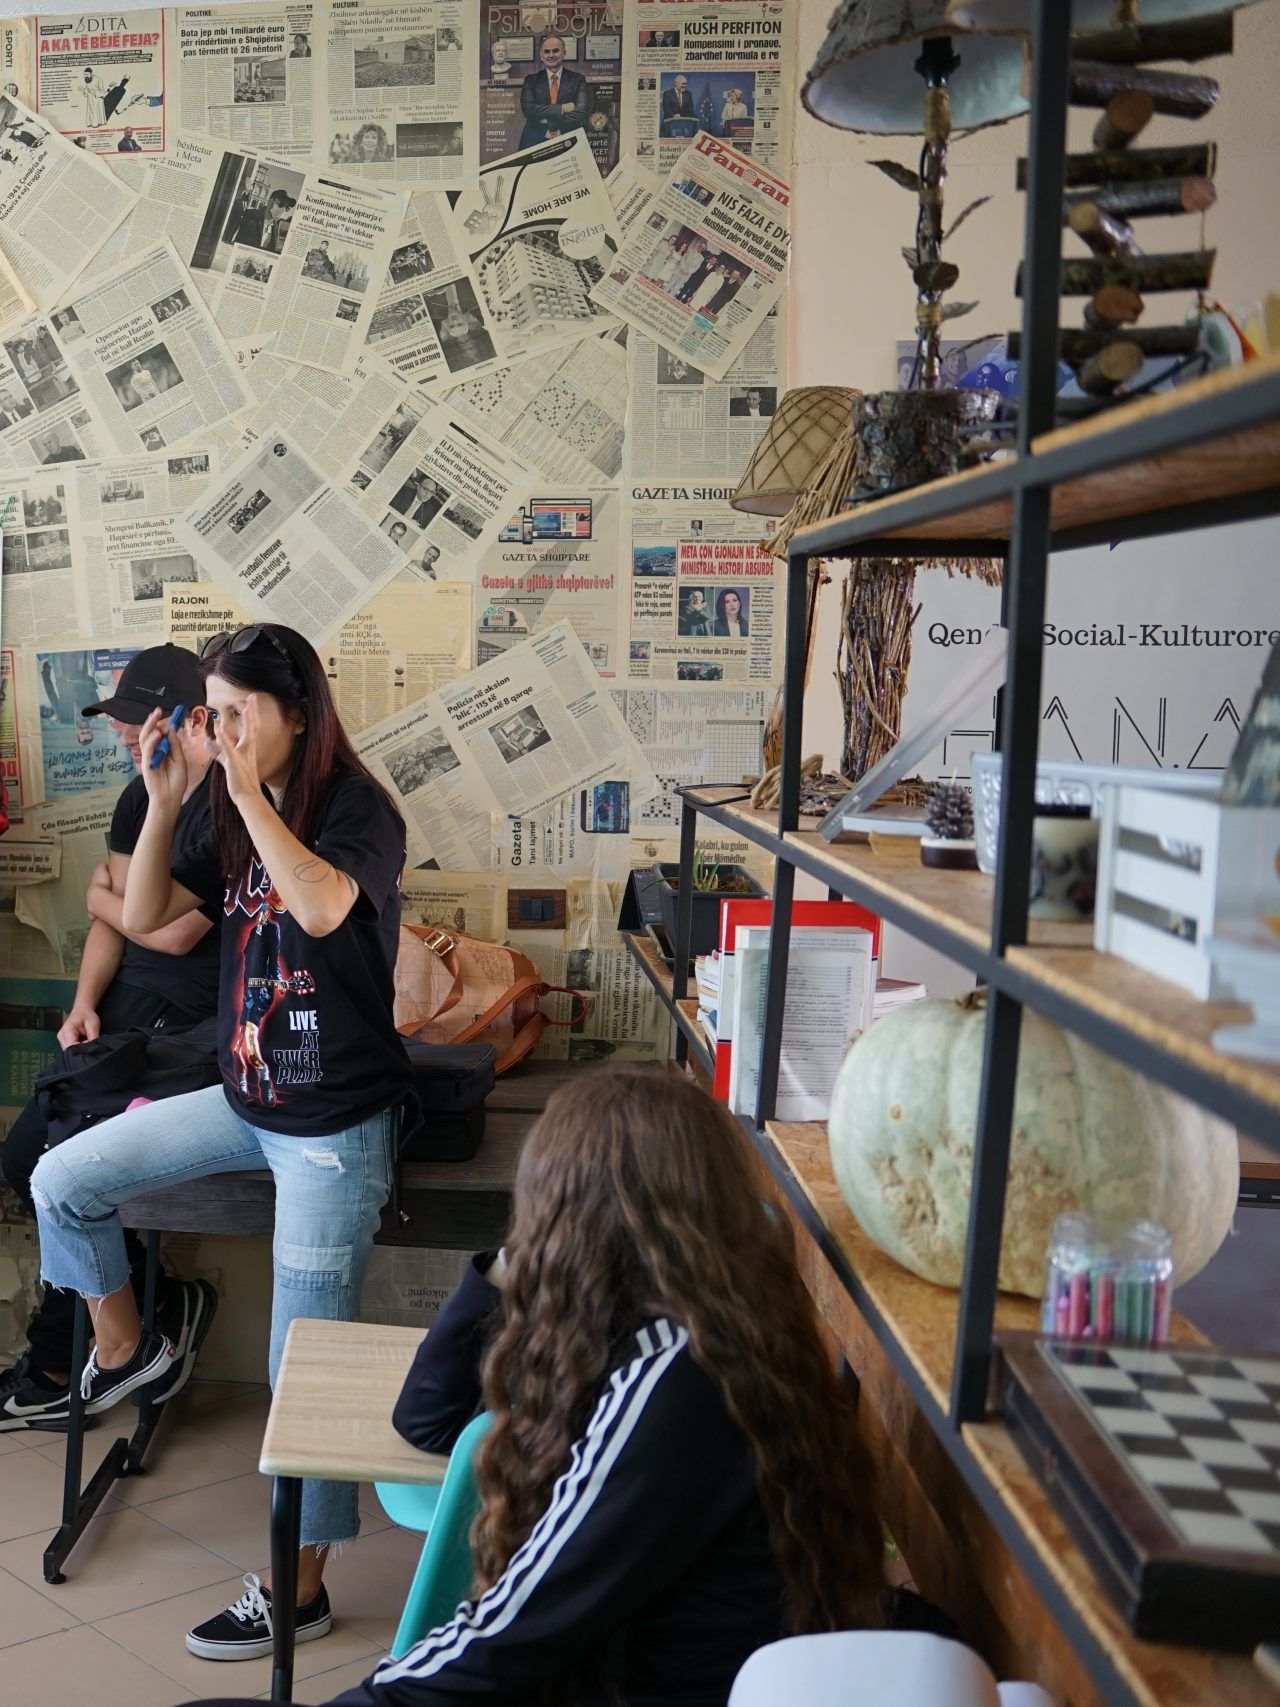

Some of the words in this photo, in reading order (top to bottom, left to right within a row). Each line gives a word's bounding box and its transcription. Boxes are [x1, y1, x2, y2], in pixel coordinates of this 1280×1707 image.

[185, 9, 212, 17] POLITIKE
[86, 16, 128, 32] DITA
[180, 28, 198, 38] Bota
[199, 28, 211, 38] jep
[213, 26, 228, 36] mbi
[266, 25, 285, 33] euro
[683, 21, 718, 35] KUSH
[721, 20, 782, 35] PERFITON
[3, 29, 12, 69] SPORTI
[50, 38, 70, 51] KA
[72, 33, 88, 50] TË
[90, 31, 120, 49] BËJË
[121, 31, 160, 47] FEJA?
[180, 39, 193, 48] për
[194, 35, 236, 46] rindërtimin
[244, 33, 285, 44] Shqipërisë
[683, 38, 735, 49] Kompensimi
[183, 49, 197, 58] pas
[198, 46, 229, 56] tërmetit
[239, 45, 250, 53] 26
[251, 43, 283, 53] nëntorit
[684, 50, 722, 61] zbardhet
[724, 50, 758, 60] formula
[768, 50, 779, 59] re
[552, 192, 573, 208] ARE
[573, 186, 590, 200] WE
[521, 201, 552, 219] HOME
[716, 190, 739, 212] NIS
[735, 203, 766, 228] FAZA
[701, 214, 730, 237] kushtet
[725, 229, 742, 246] për
[709, 205, 735, 227] Shtëpi
[731, 220, 746, 233] me
[742, 226, 765, 245] kredi
[631, 486, 690, 500] GAZETA
[502, 552, 537, 562] GAZETA
[539, 552, 590, 562] SHQIPTARE
[170, 596, 209, 605] RAJONI
[928, 623, 1001, 647] Qen
[446, 694, 474, 715] Policia
[471, 688, 484, 700] në
[482, 674, 510, 694] aksion
[455, 706, 495, 732] arrestuar
[492, 699, 505, 712] në
[508, 684, 534, 704] qarqe
[511, 820, 521, 866] Gazeta
[289, 1010, 318, 1030] LIVE
[301, 1031, 319, 1050] AT
[273, 1050, 320, 1068] RIVER
